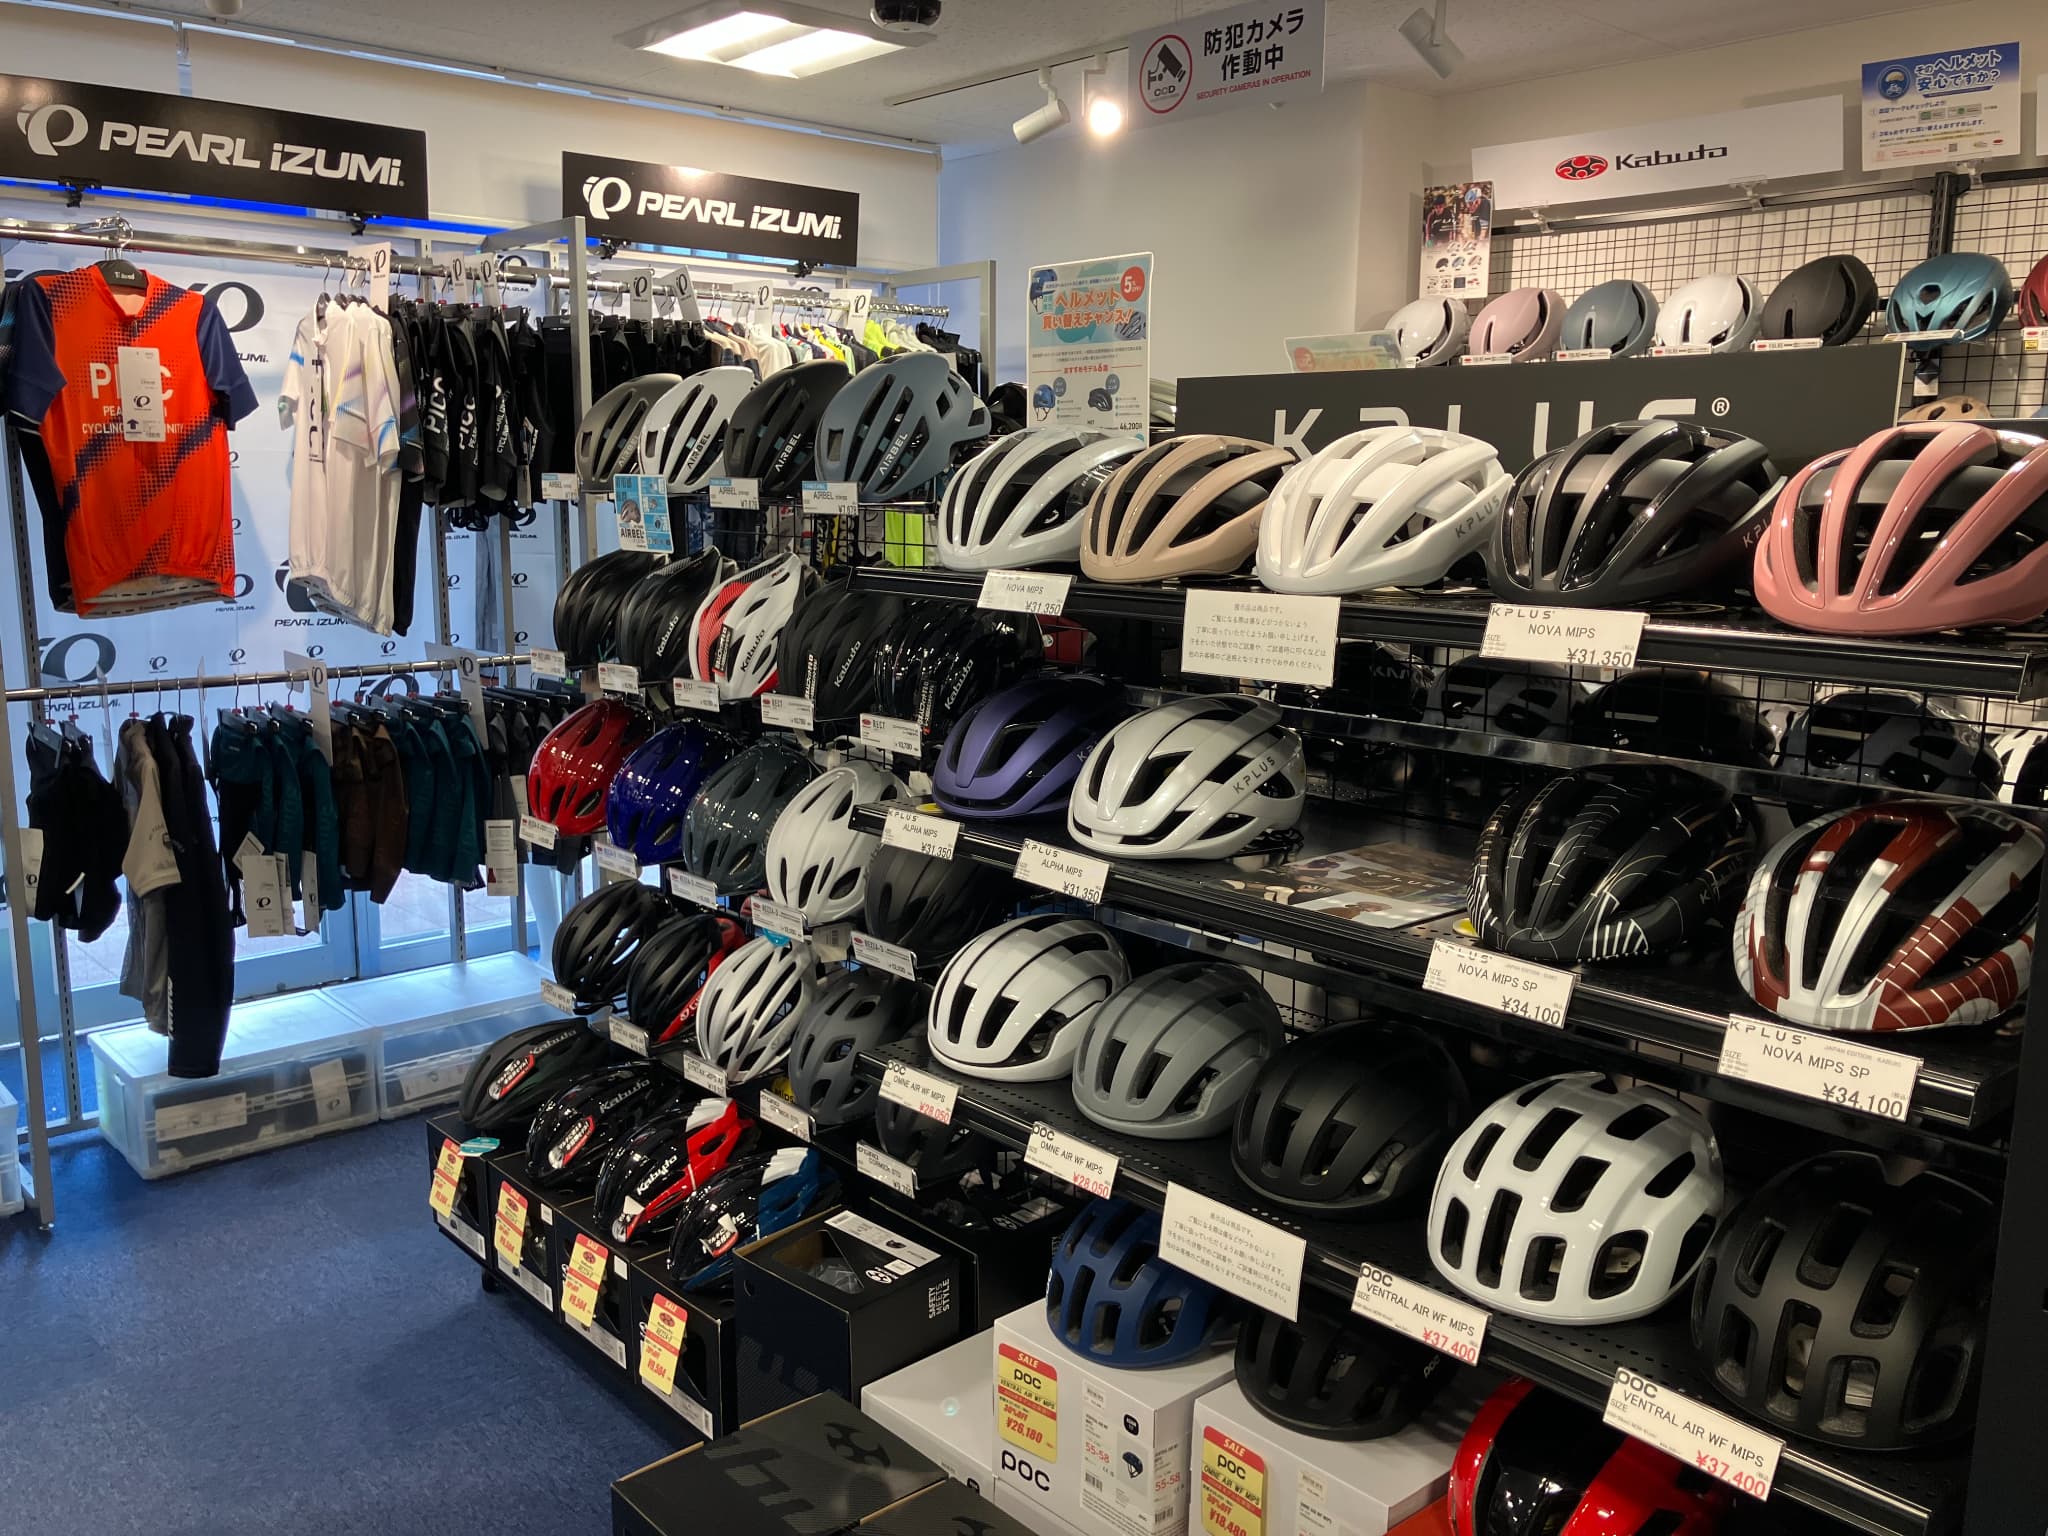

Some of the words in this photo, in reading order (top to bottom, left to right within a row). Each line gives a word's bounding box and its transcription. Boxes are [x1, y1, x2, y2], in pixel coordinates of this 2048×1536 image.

[1203, 8, 1305, 57] 防犯カメラ
[1221, 43, 1284, 82] 作動中
[1914, 49, 2002, 77] そのヘルメット
[1196, 86, 1228, 101] SECURITY
[1229, 79, 1262, 94] CAMERAS
[1262, 77, 1270, 88] IN
[1270, 69, 1312, 85] OPERATION
[100, 121, 261, 169] PEARL
[1615, 144, 1728, 171] Kabuto
[636, 190, 745, 229] PEARL
[1054, 286, 1122, 311] ヘルメット
[1123, 275, 1133, 293] 5
[618, 434, 639, 467] AIRBE
[687, 432, 711, 469] AIRBEL
[774, 431, 802, 473] AIRBEL
[879, 433, 909, 476] AIRBEL
[620, 526, 645, 539] AIRBEL
[1454, 496, 1500, 539] KPLUS
[1006, 583, 1025, 593] NOVA
[1026, 586, 1045, 595] MIPS
[274, 618, 314, 628] PEARL
[1491, 606, 1552, 620] KPLUS
[656, 615, 680, 657] Kabuto
[1528, 623, 1562, 637] NOVA
[1565, 626, 1597, 639] MIPS
[740, 628, 766, 673] Kabuto
[833, 639, 862, 688] Kabuto
[1566, 646, 1633, 667] ¥31,350
[944, 658, 975, 710] Kabuto
[42, 702, 75, 713] EARL
[1232, 756, 1277, 795] KPLUS
[888, 810, 919, 822] KPLUS
[902, 823, 922, 834] ALPHA
[922, 827, 939, 838] MIPS
[1023, 842, 1060, 858] KPLUS
[1040, 859, 1064, 873] ALPHA
[1065, 865, 1084, 878] MIPS
[1457, 962, 1489, 980] NOVA
[1491, 972, 1519, 988] MIPS
[1521, 980, 1538, 993] SP
[1500, 994, 1562, 1026] ¥34,100
[530, 1029, 577, 1055] Kabuto
[1729, 1019, 1802, 1045] KPLUS
[1723, 1049, 1742, 1061] SIZE
[1762, 1043, 1804, 1065] NOVA
[1808, 1055, 1845, 1075] MIPS
[1849, 1065, 1871, 1080] SP
[600, 1079, 650, 1114] Kabuto
[893, 1075, 911, 1088] OMNE
[910, 1082, 921, 1093] AIR
[930, 1090, 946, 1103] MIPS
[1822, 1081, 1904, 1119] ¥34,100
[1040, 1140, 1061, 1156] OMNE
[1061, 1150, 1073, 1161] AIR
[1074, 1154, 1086, 1166] WF
[1085, 1160, 1104, 1175] MIPS
[928, 1286, 936, 1319] SAFETY
[935, 1282, 943, 1316] MEETS
[942, 1277, 950, 1312] STYLE
[1366, 1281, 1410, 1309] VENTRAL
[1412, 1303, 1430, 1318] AIR
[1432, 1309, 1448, 1323] WF
[1449, 1318, 1475, 1337] MIPS
[1017, 1352, 1040, 1369] SALE
[1422, 1327, 1477, 1363] ¥37,400
[1000, 1378, 1023, 1396] VENTRAL
[1023, 1388, 1033, 1399] AIR
[1042, 1397, 1055, 1410] MIPS
[1608, 1398, 1629, 1414] SIZE
[1005, 1416, 1044, 1445] ¥26,180
[1623, 1389, 1682, 1427] VENTRAL
[1682, 1420, 1705, 1440] AIR
[1708, 1431, 1729, 1449] WF
[1730, 1442, 1765, 1468] MIPS
[1084, 1441, 1111, 1465] 55-58
[1222, 1438, 1247, 1458] SALE
[1154, 1471, 1181, 1492] 55-58
[1203, 1463, 1222, 1481] OMNE
[1221, 1473, 1234, 1488] AIR
[1244, 1489, 1261, 1506] MIPS
[1695, 1448, 1768, 1498] ¥37,400
